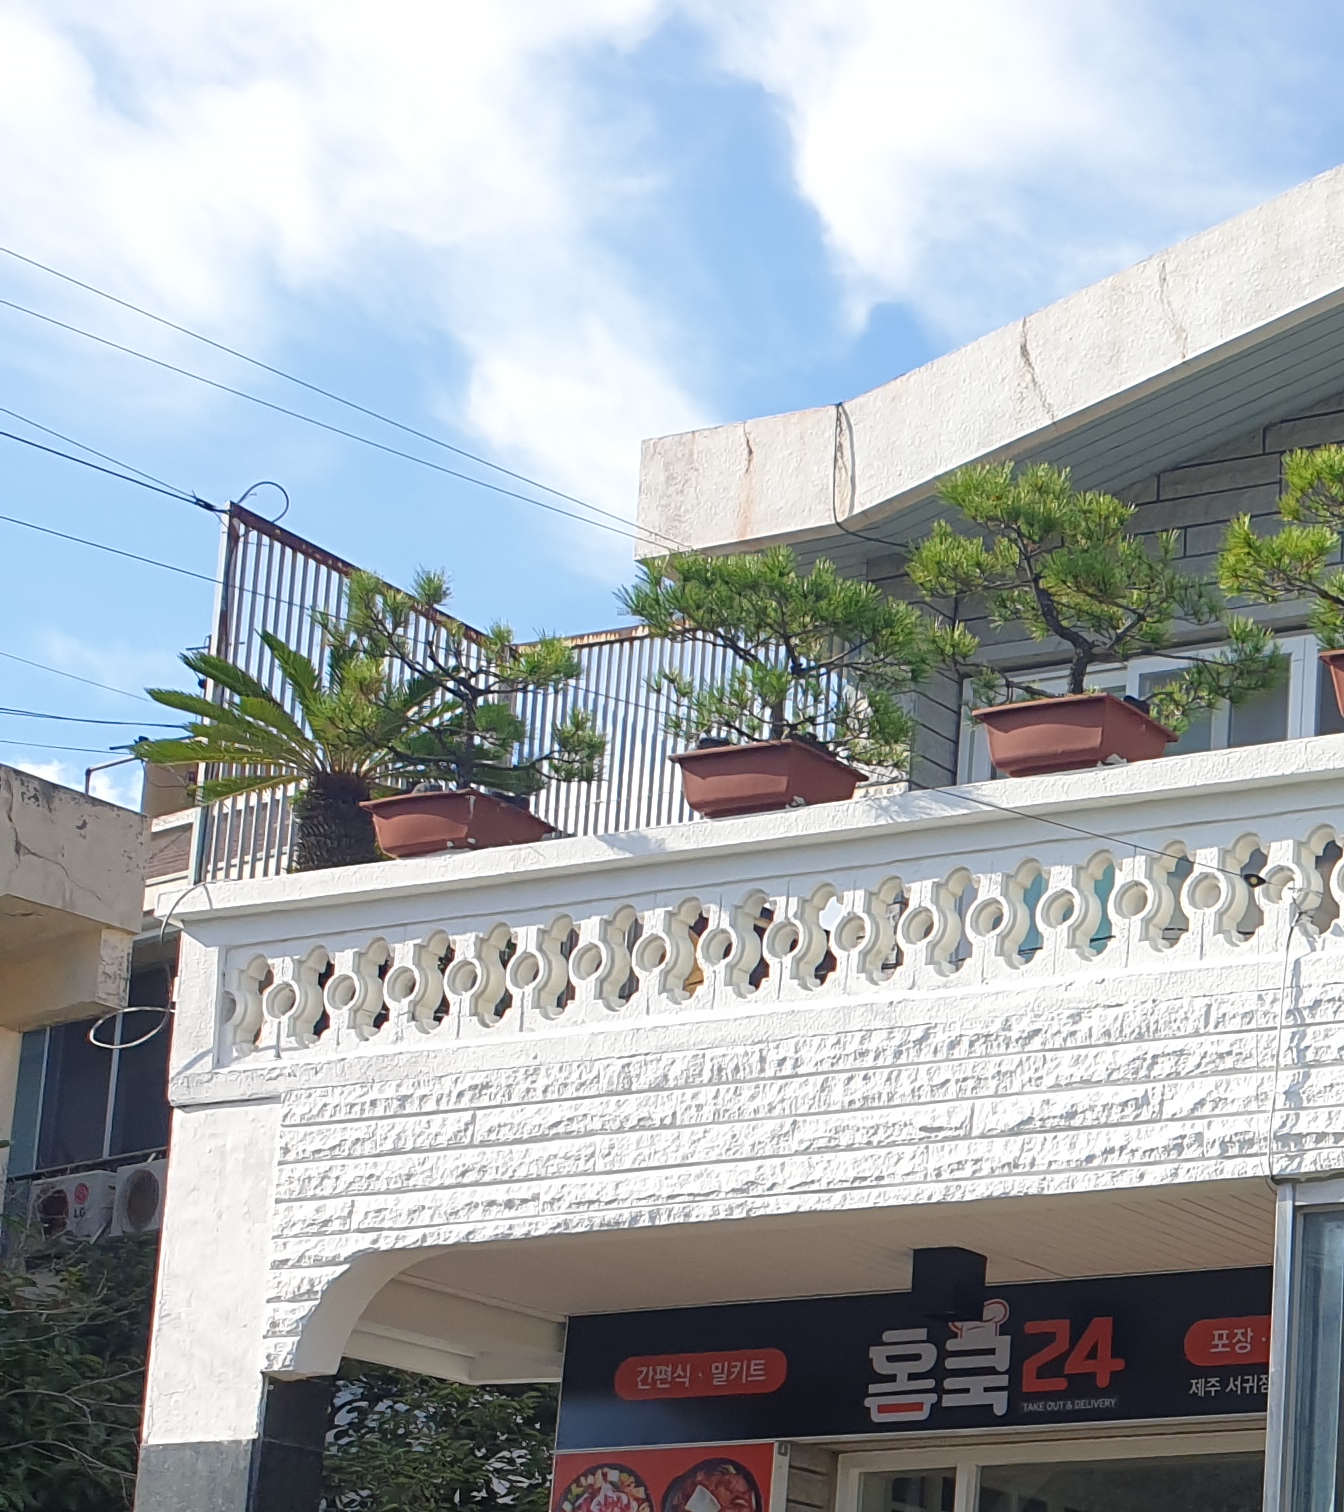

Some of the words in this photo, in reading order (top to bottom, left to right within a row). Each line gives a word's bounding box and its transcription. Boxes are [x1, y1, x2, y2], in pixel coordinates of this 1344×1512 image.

[73, 1206, 87, 1219] LG
[1210, 1327, 1253, 1353] 포장
[637, 1363, 691, 1390] 간편식
[711, 1359, 766, 1386] 밀키트
[1189, 1378, 1221, 1397] 제주
[1023, 1401, 1045, 1412] TAKE
[1046, 1400, 1064, 1411] OUT
[1074, 1398, 1117, 1410] DELIVERY
